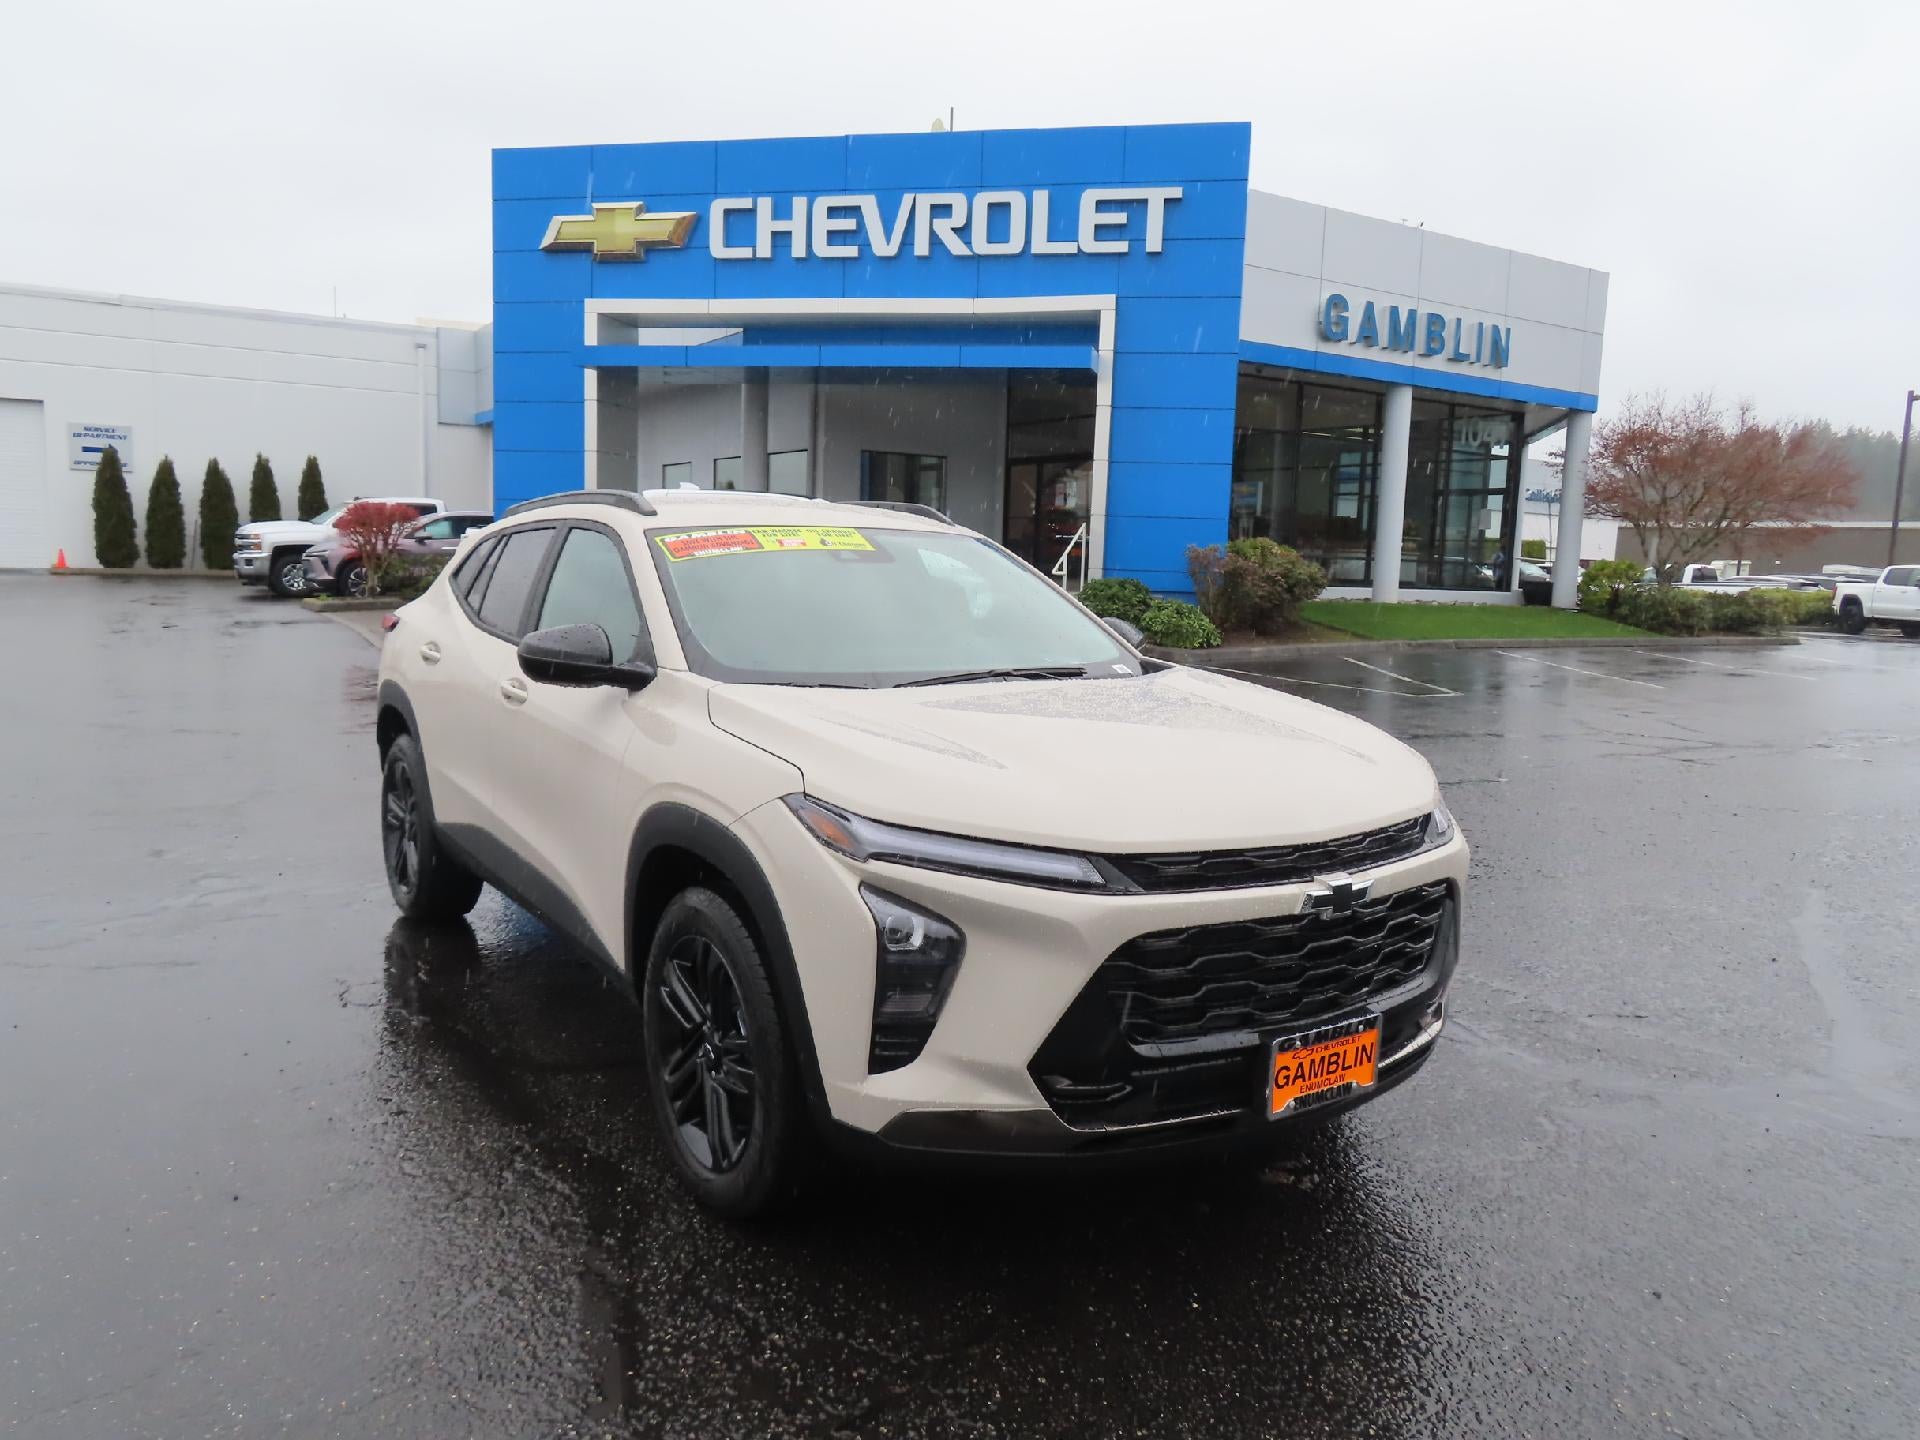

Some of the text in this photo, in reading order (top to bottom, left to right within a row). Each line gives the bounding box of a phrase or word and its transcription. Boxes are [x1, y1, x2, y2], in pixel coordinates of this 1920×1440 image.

[709, 187, 1183, 258] CHEVROLET
[1323, 293, 1511, 369] GAMBLIN
[72, 432, 128, 440] DEPARTMENT
[83, 426, 116, 434] SERVICE
[1315, 1036, 1362, 1054] CHEVROLET
[1274, 1042, 1375, 1090] GAMBLIN
[1299, 1074, 1346, 1094] ENUMCLAW
[1293, 1082, 1353, 1111] ENUMCLAW
